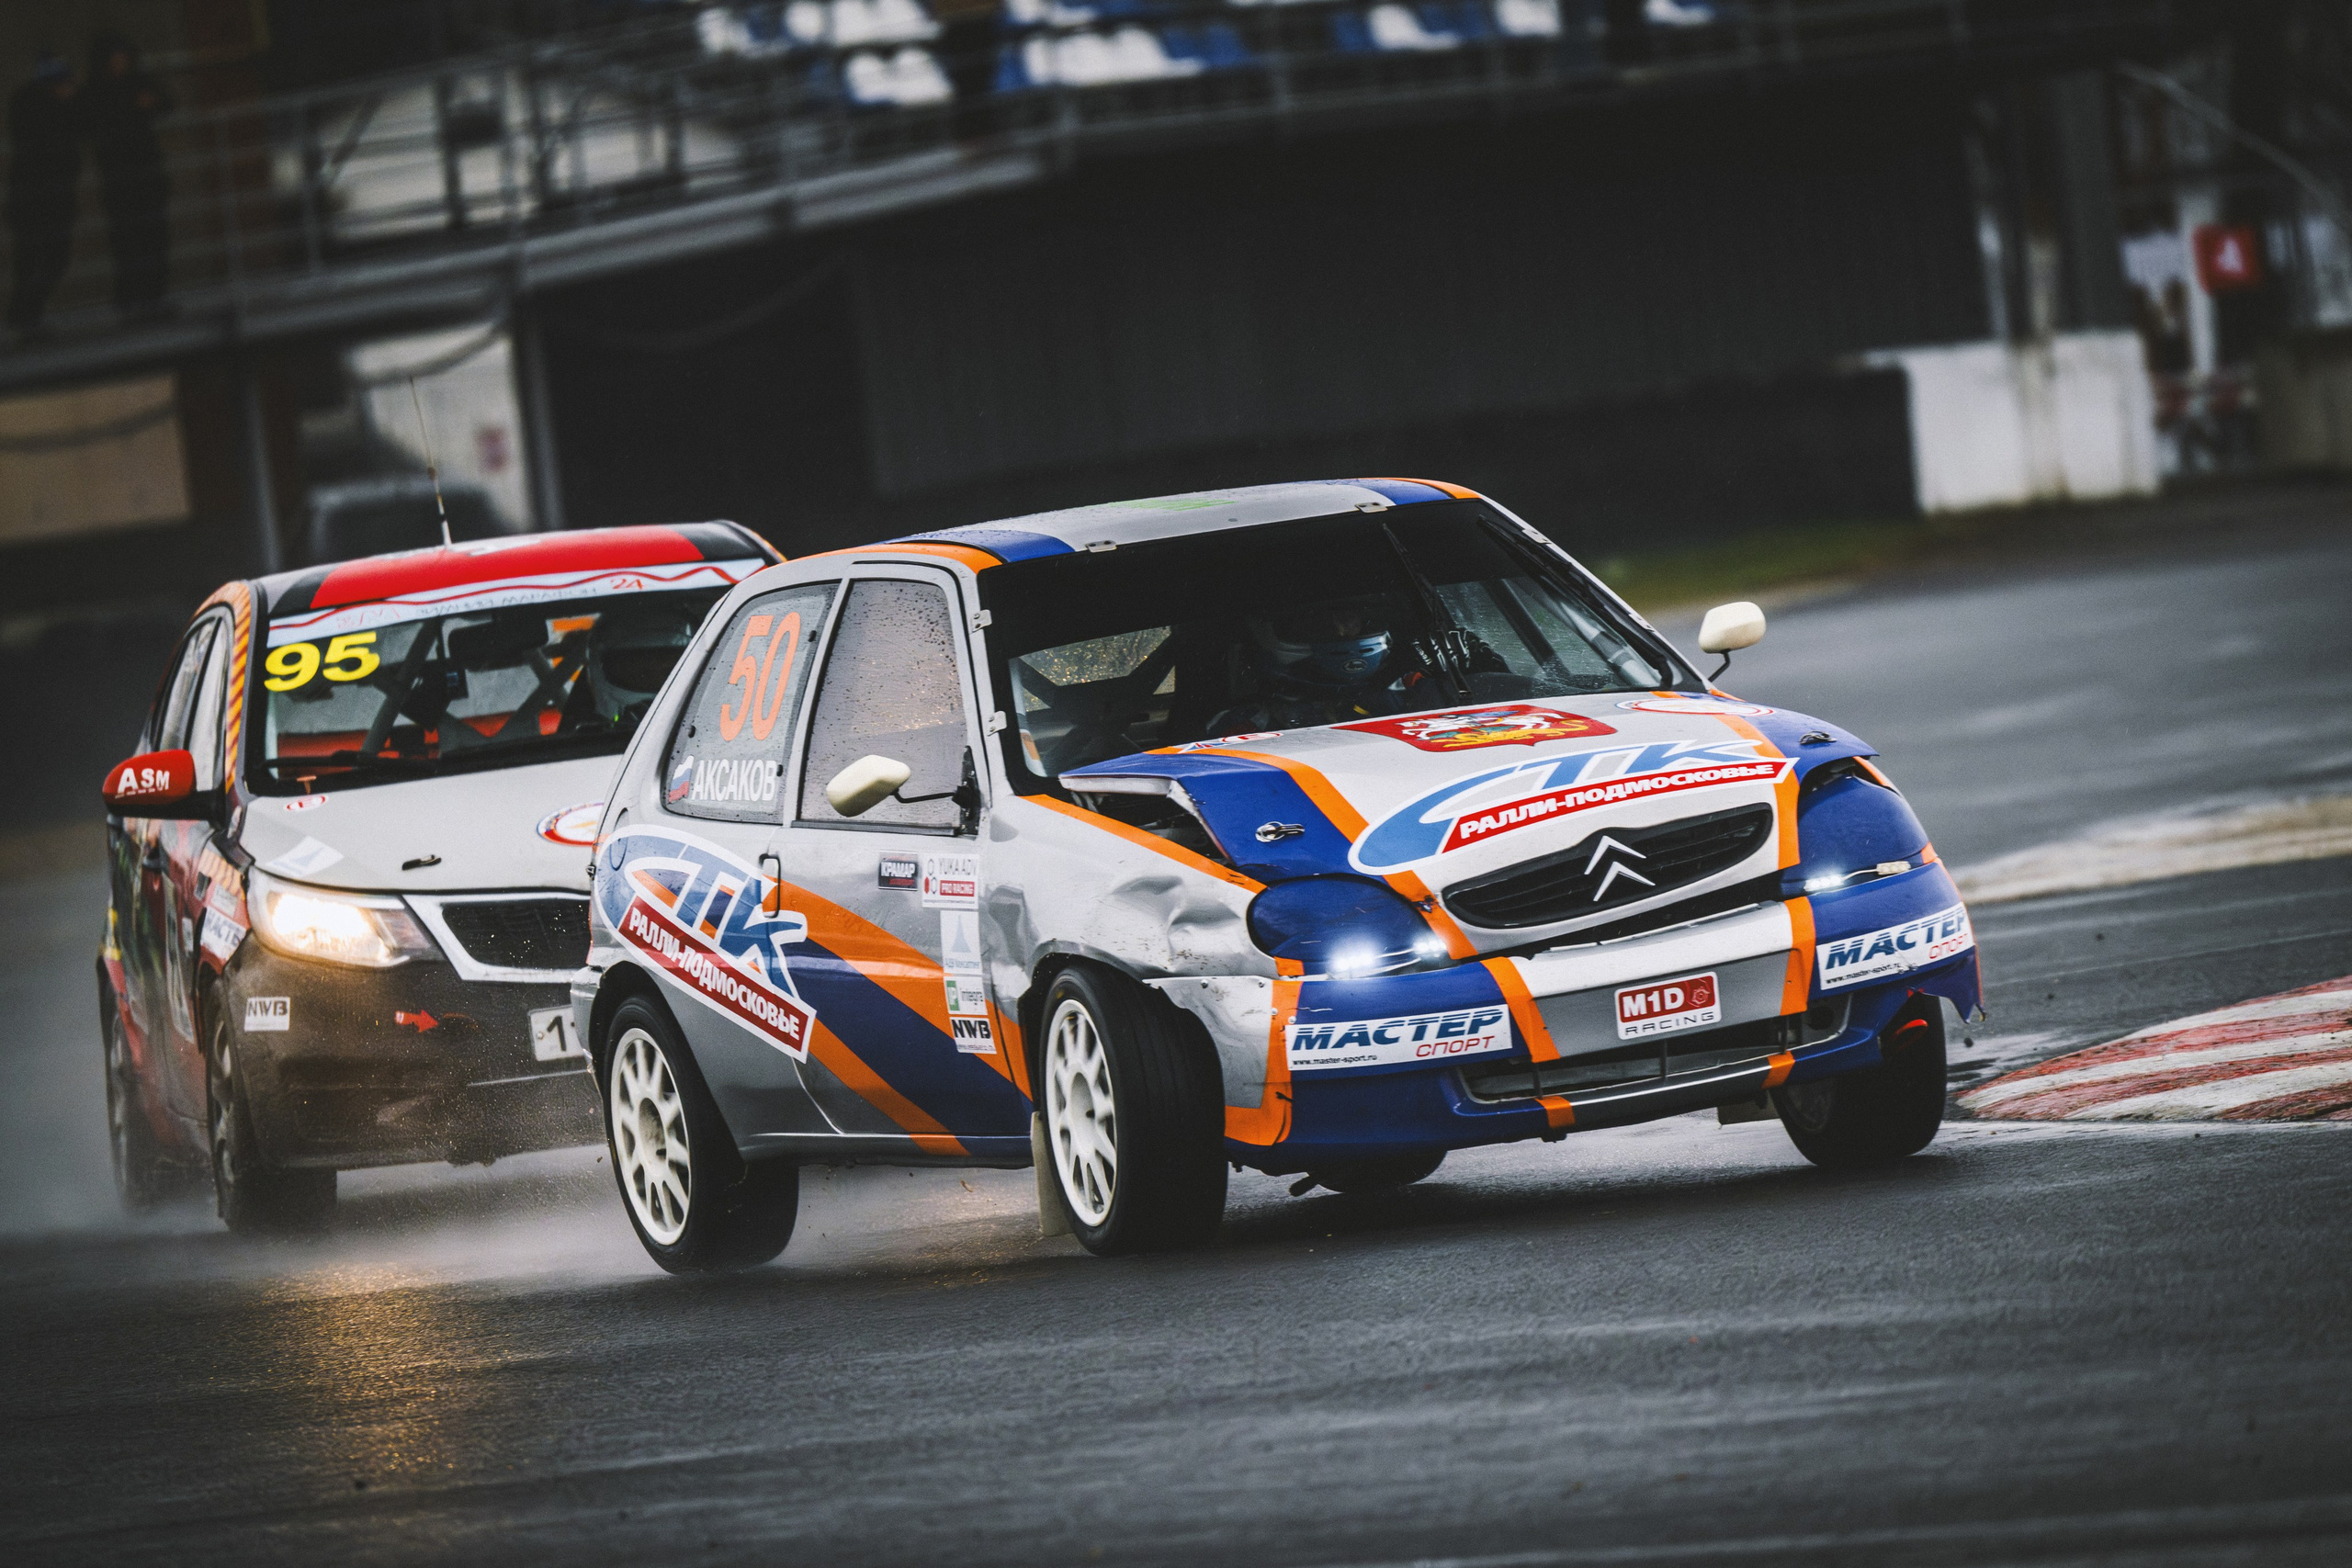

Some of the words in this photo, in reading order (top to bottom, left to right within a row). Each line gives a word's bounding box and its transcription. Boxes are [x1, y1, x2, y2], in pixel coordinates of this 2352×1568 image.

[264, 631, 380, 692] 95
[720, 612, 801, 741] 50
[117, 767, 170, 795] ASM
[692, 759, 778, 802] АКСАКОВ
[1460, 763, 1776, 839] РАЛЛИ-ПОДМОСКОВЬЕ
[1826, 906, 1966, 971] МАСТЕР
[628, 907, 800, 1041] РАЛЛИ-ПОДМОСКОВЬЕ
[1622, 987, 1685, 1018] M1D
[1624, 1011, 1714, 1036] RACING
[951, 1019, 991, 1040] NWB
[1292, 1009, 1503, 1051] МАСТЕР
[1416, 1035, 1496, 1057] СПОРТ
[1292, 1054, 1378, 1066] www.master-sport.ru
